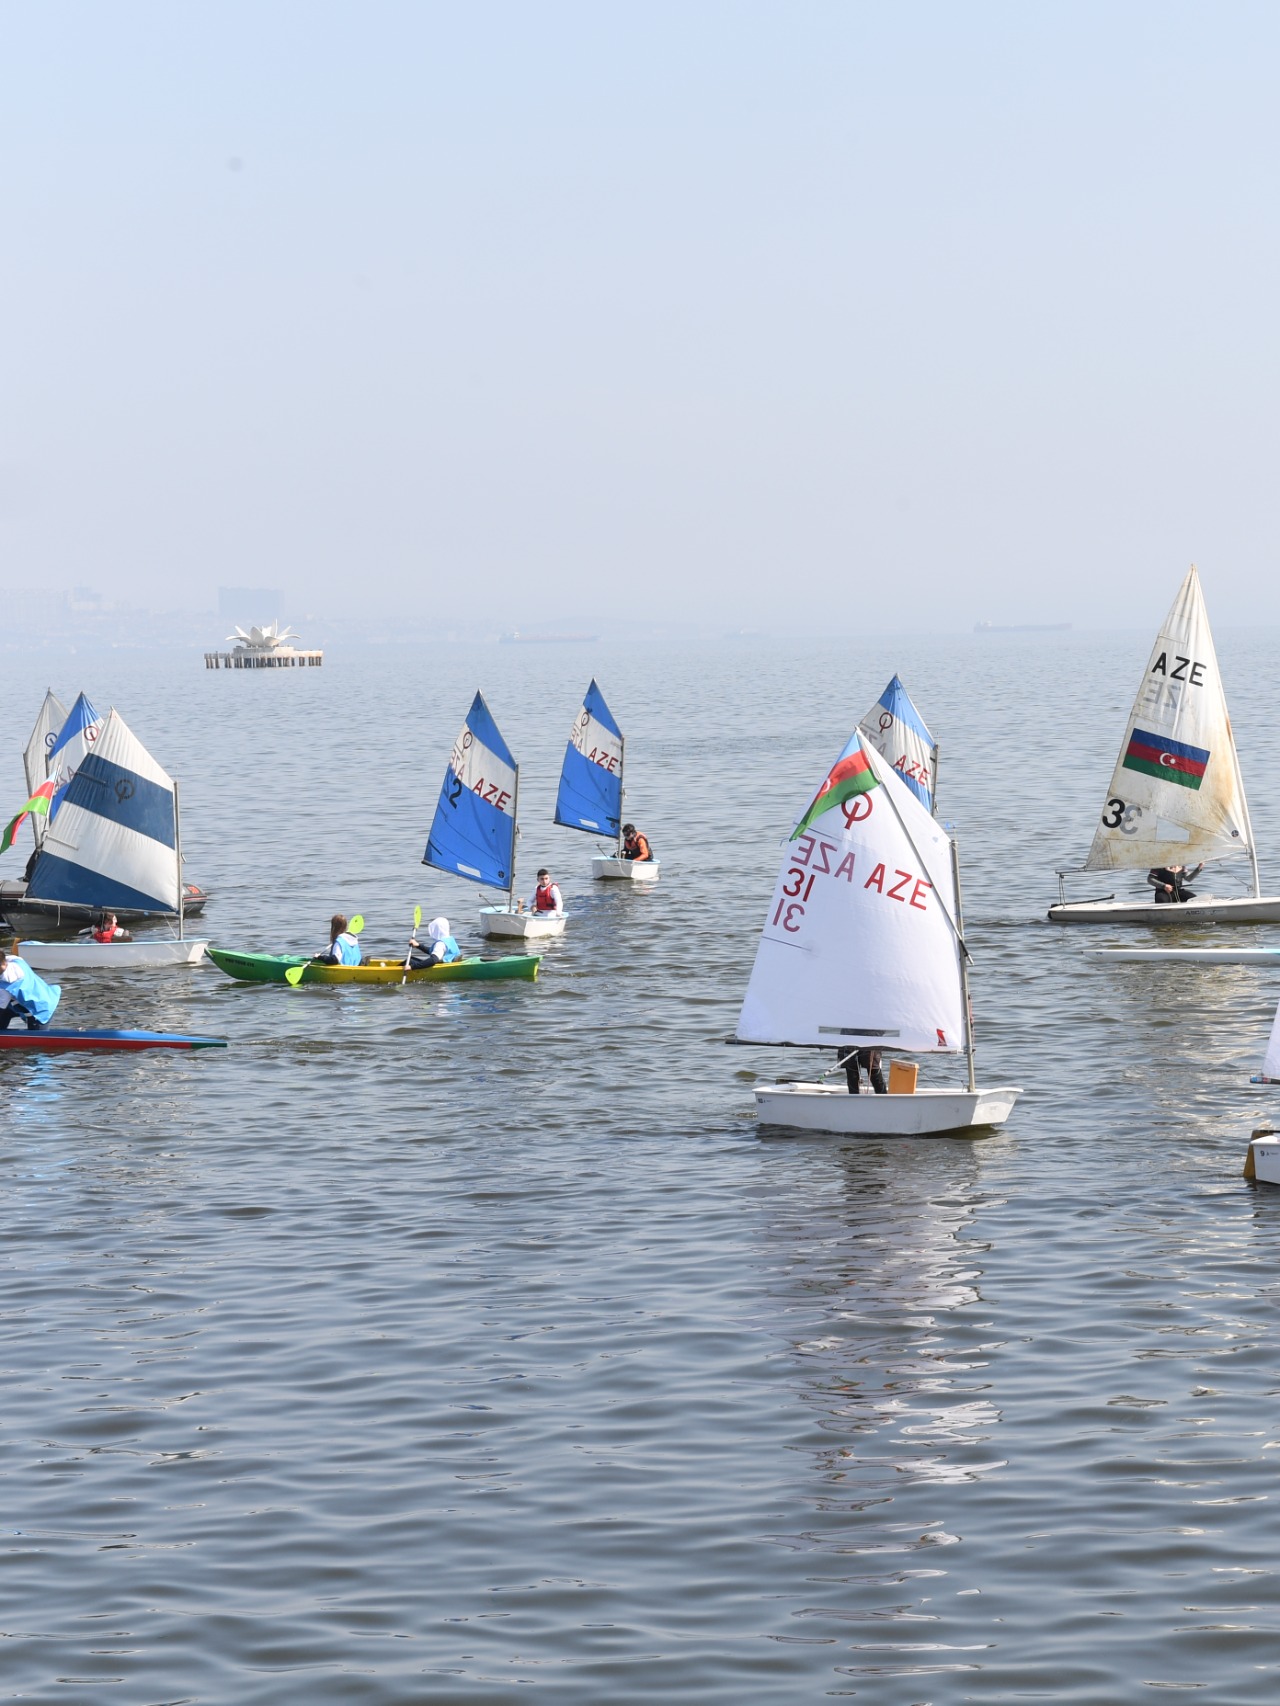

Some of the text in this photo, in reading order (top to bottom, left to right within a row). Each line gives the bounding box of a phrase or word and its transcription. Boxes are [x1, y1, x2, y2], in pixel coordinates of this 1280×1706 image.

[1151, 652, 1207, 687] AZE
[588, 747, 619, 773] AZE
[893, 755, 931, 786] AZE
[448, 777, 463, 809] 2
[472, 777, 512, 811] AZE
[1102, 798, 1126, 829] 3
[783, 867, 816, 902] 31
[864, 862, 933, 911] AZE
